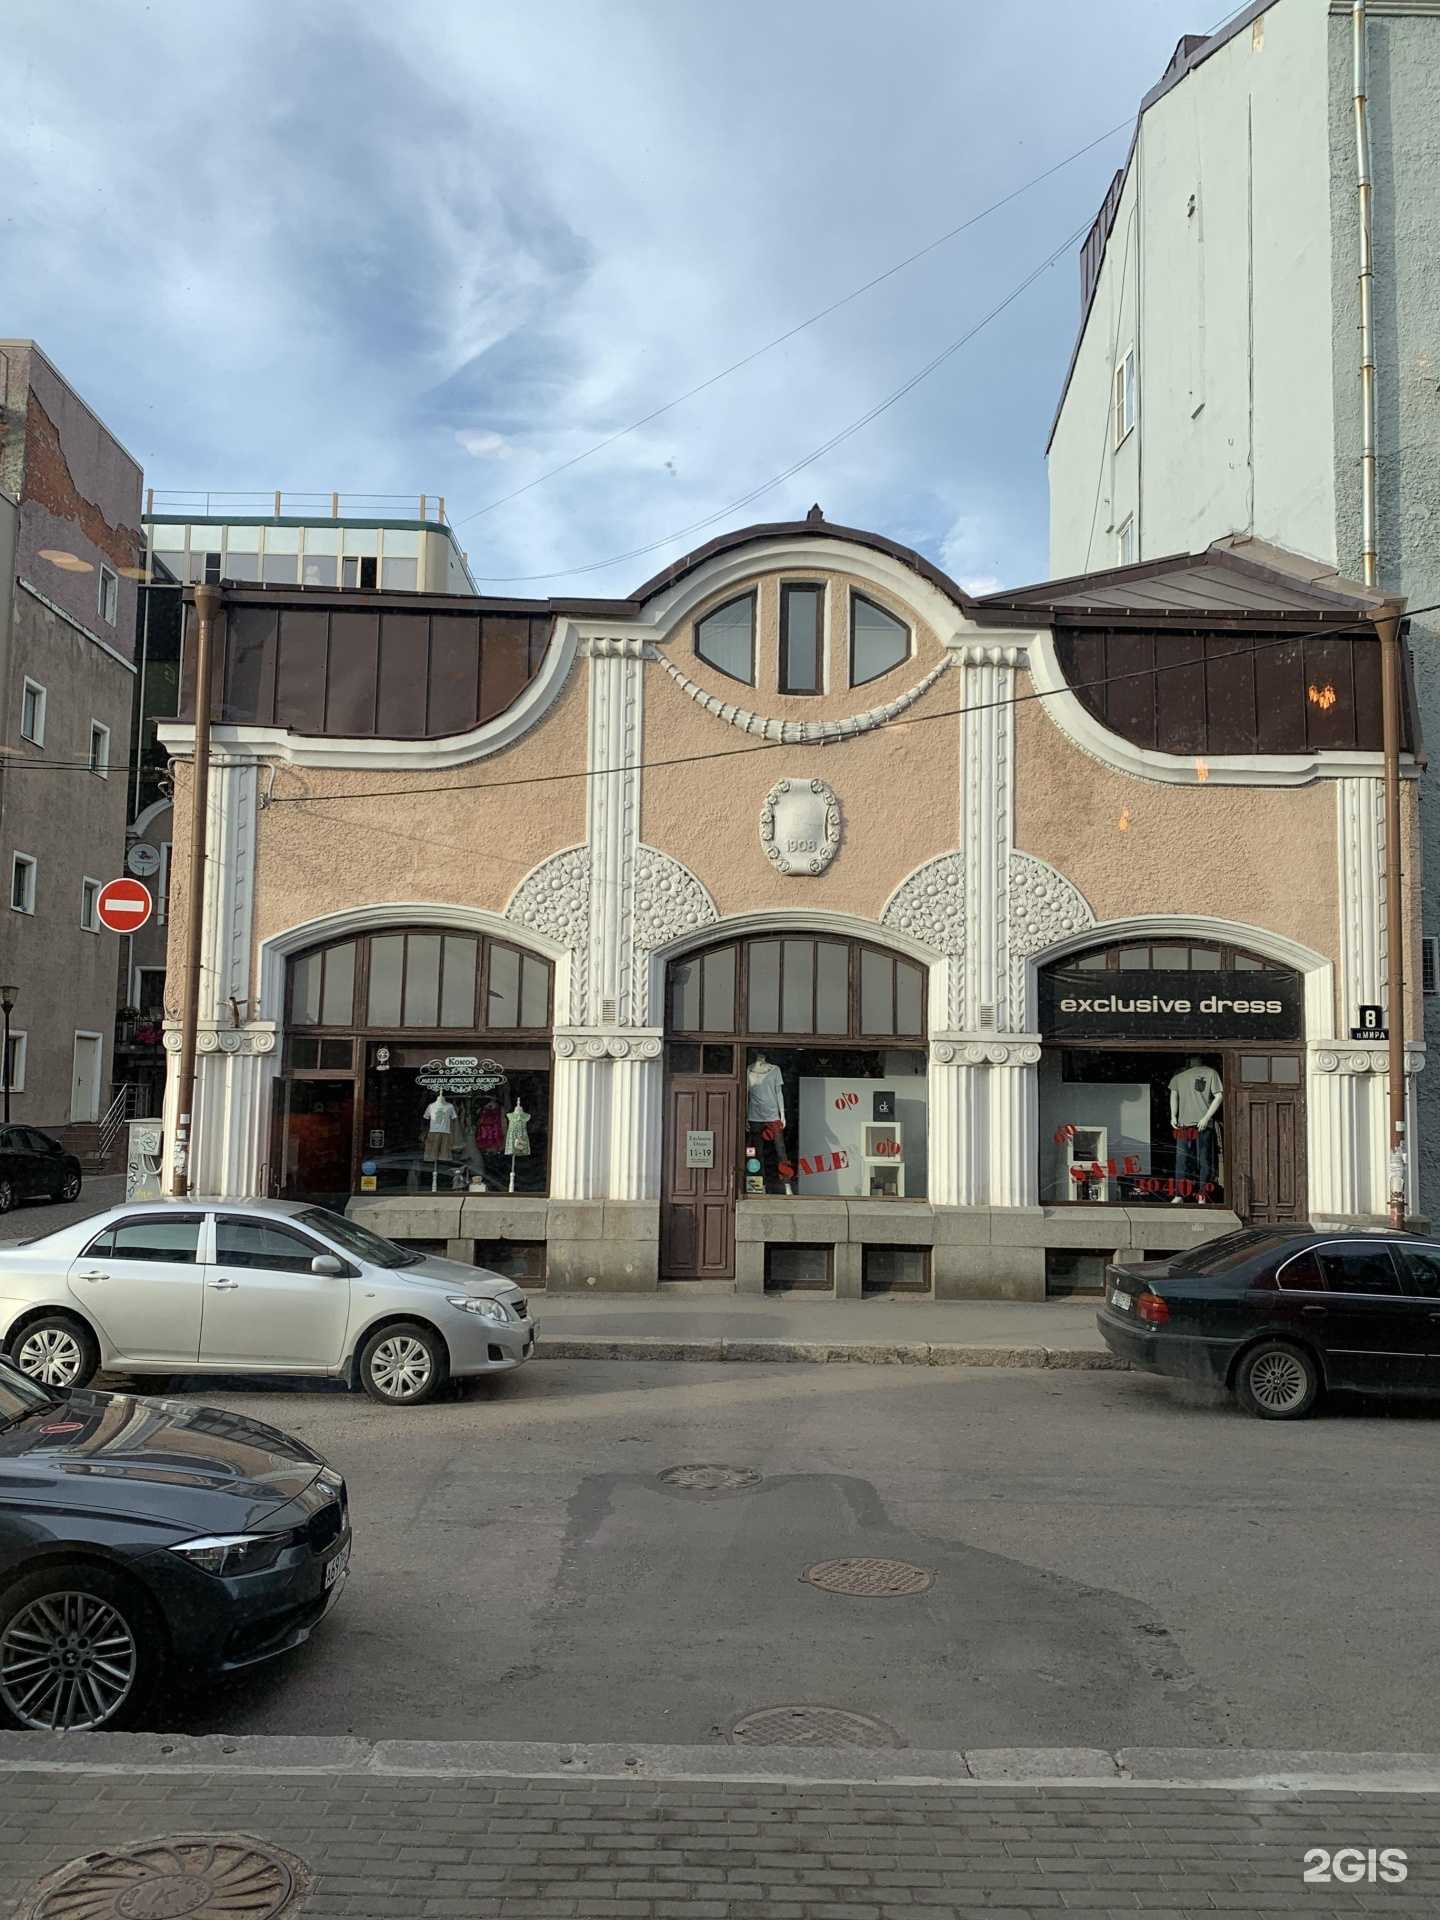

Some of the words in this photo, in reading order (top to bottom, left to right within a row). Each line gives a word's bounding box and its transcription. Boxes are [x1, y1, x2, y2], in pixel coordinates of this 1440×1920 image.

[787, 840, 817, 853] 1908
[1060, 995, 1191, 1013] exclusive
[1199, 995, 1282, 1014] dress
[1365, 1010, 1376, 1028] 8
[1362, 1031, 1386, 1039] МИРА
[448, 1057, 476, 1066] Кокос
[777, 1151, 849, 1180] SALE
